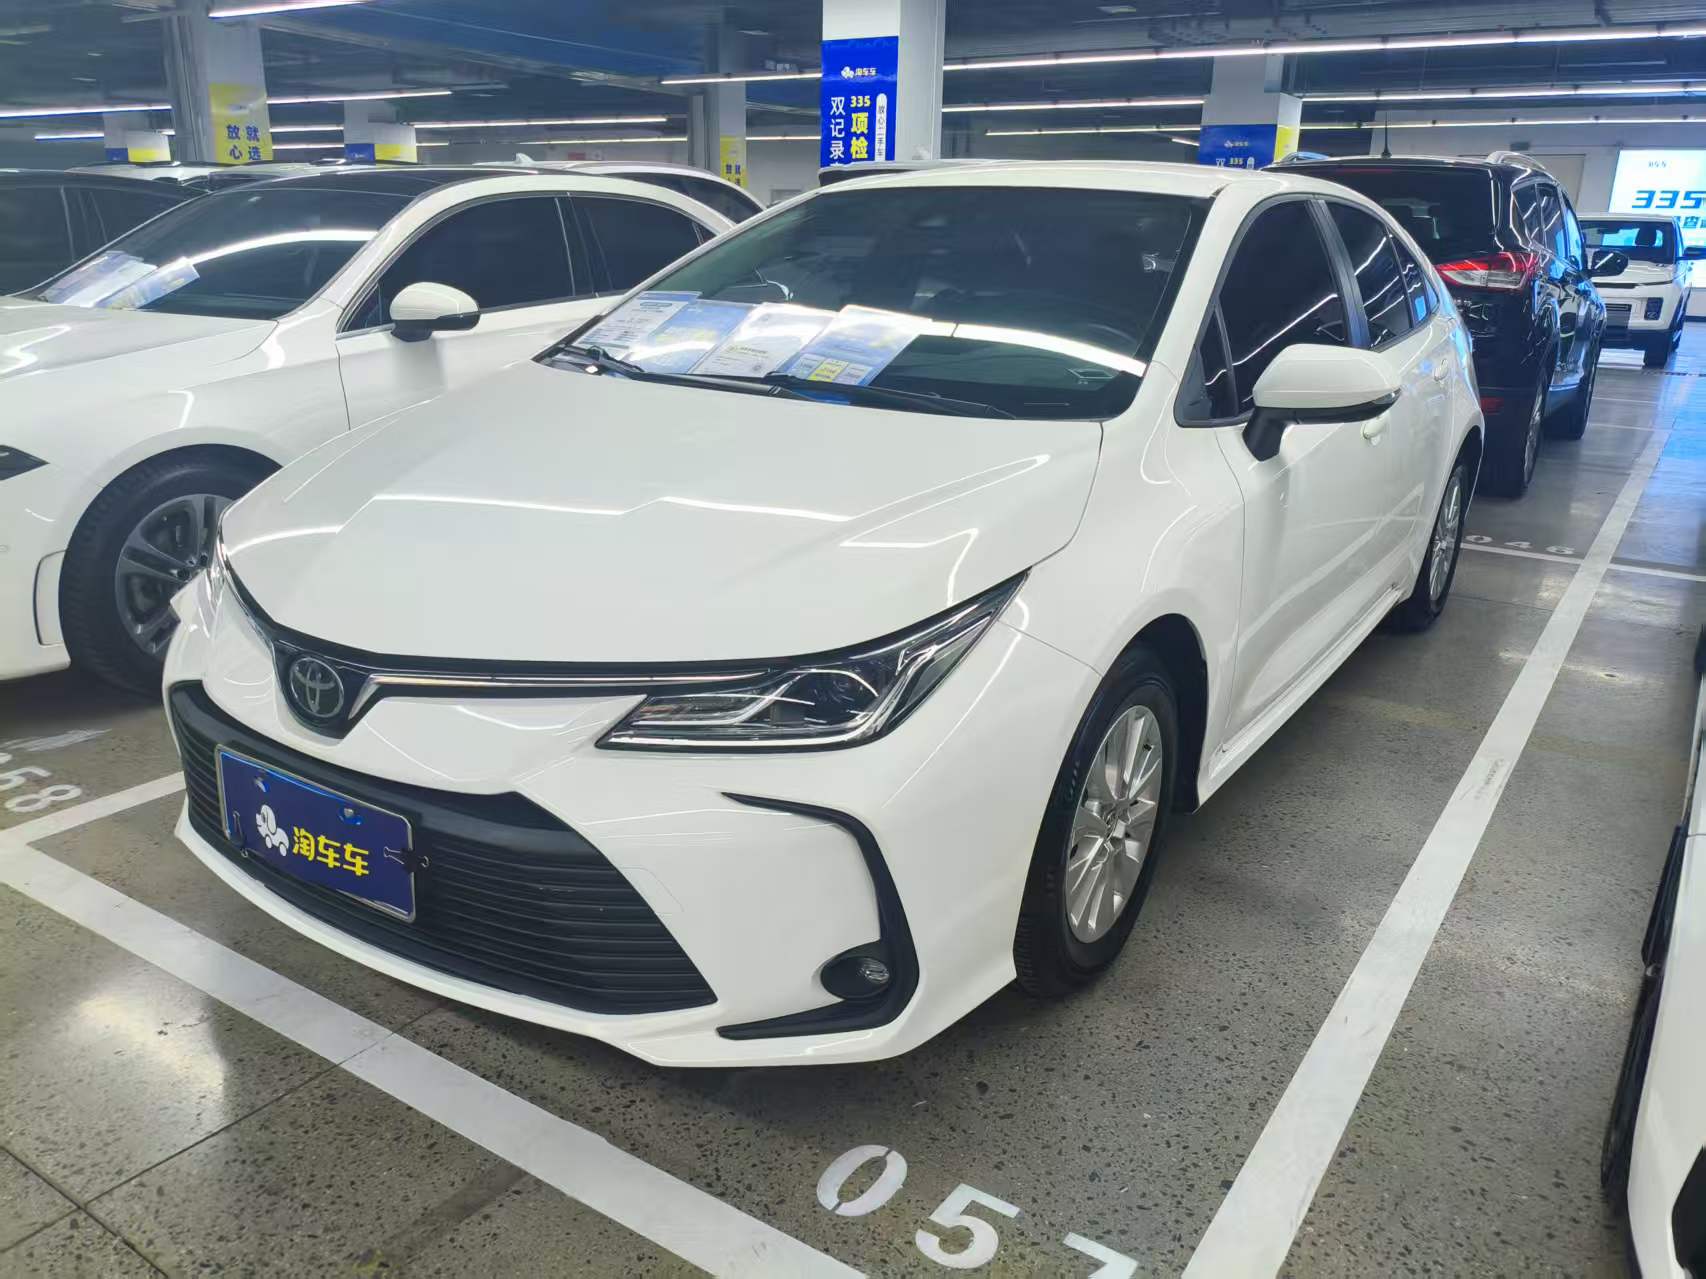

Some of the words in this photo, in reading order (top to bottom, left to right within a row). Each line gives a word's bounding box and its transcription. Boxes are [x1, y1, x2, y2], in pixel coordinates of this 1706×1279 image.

[850, 96, 871, 108] 335
[830, 96, 846, 166] 双记录
[1632, 190, 1706, 209] 335
[0, 752, 83, 813] 58
[292, 826, 369, 876] 淘车车
